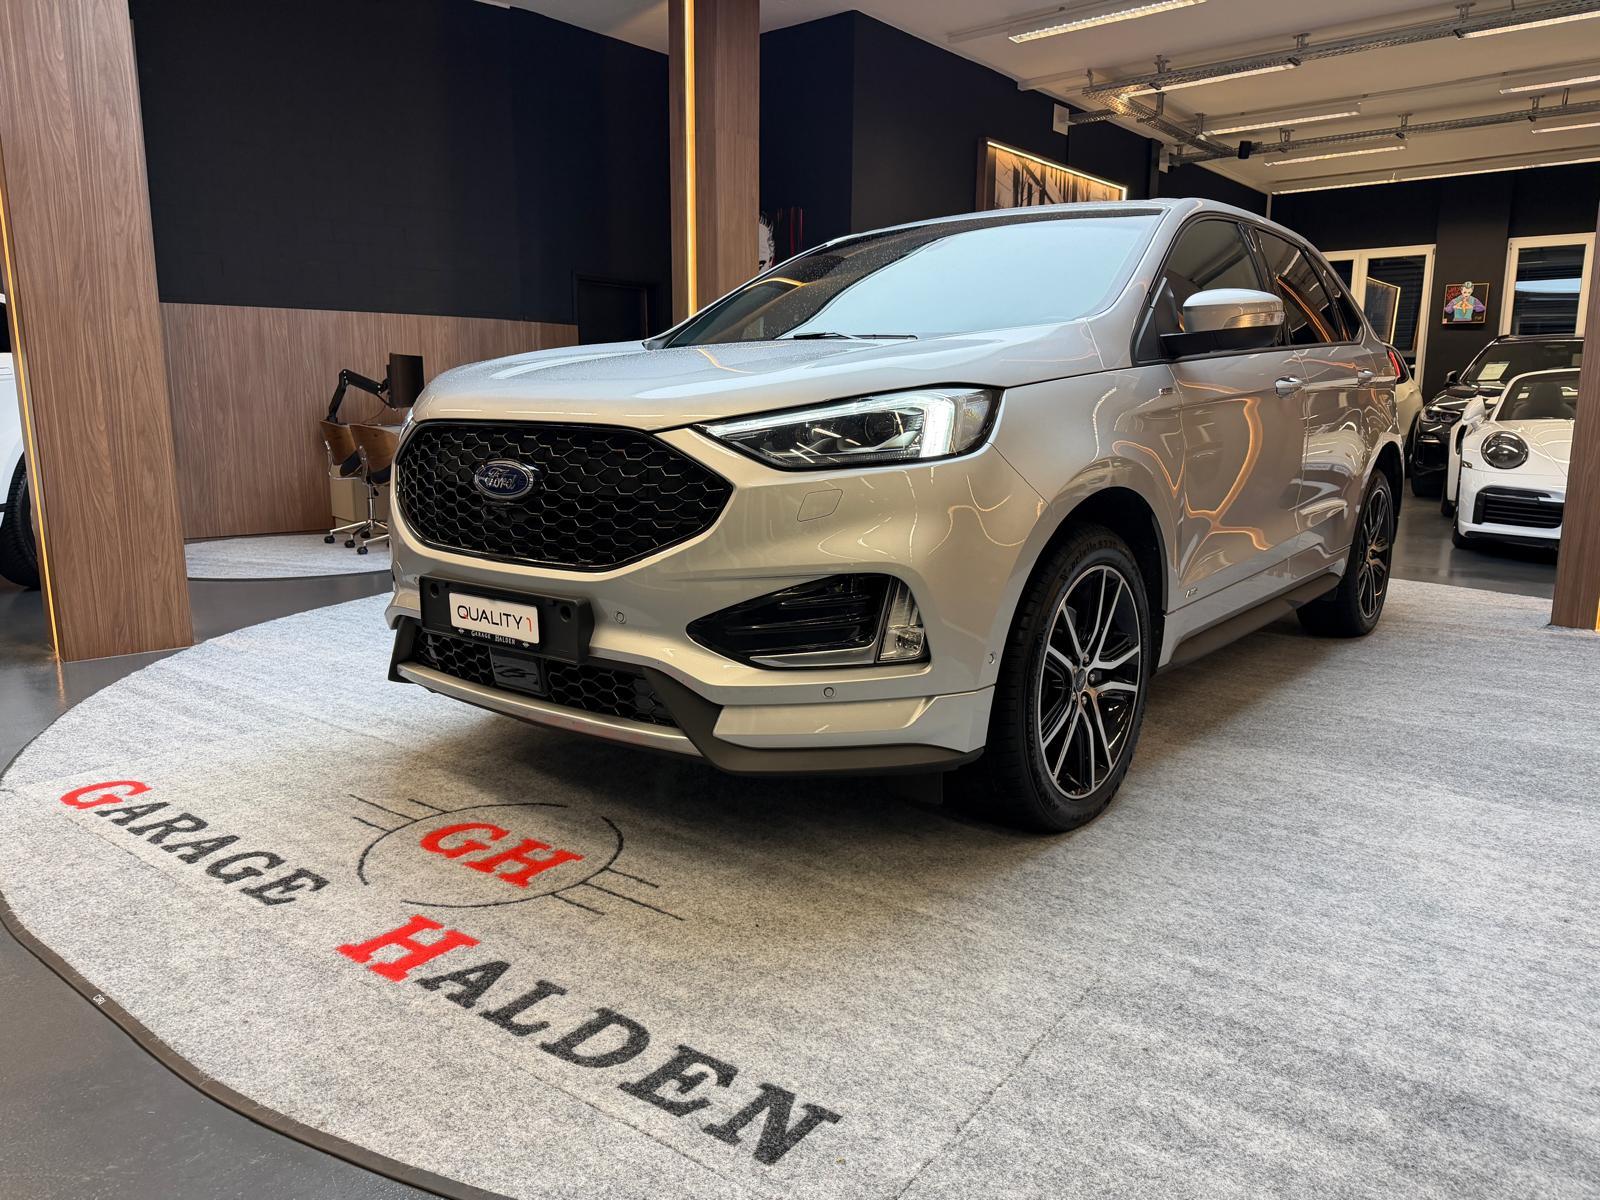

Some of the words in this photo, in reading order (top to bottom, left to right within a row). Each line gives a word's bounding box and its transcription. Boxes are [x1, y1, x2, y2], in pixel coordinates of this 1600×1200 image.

[480, 467, 517, 490] Ford
[457, 605, 522, 630] QUALITY
[526, 617, 533, 633] 1
[419, 821, 585, 889] GH
[60, 780, 329, 905] GARAGE
[335, 913, 842, 1165] HALDEN
